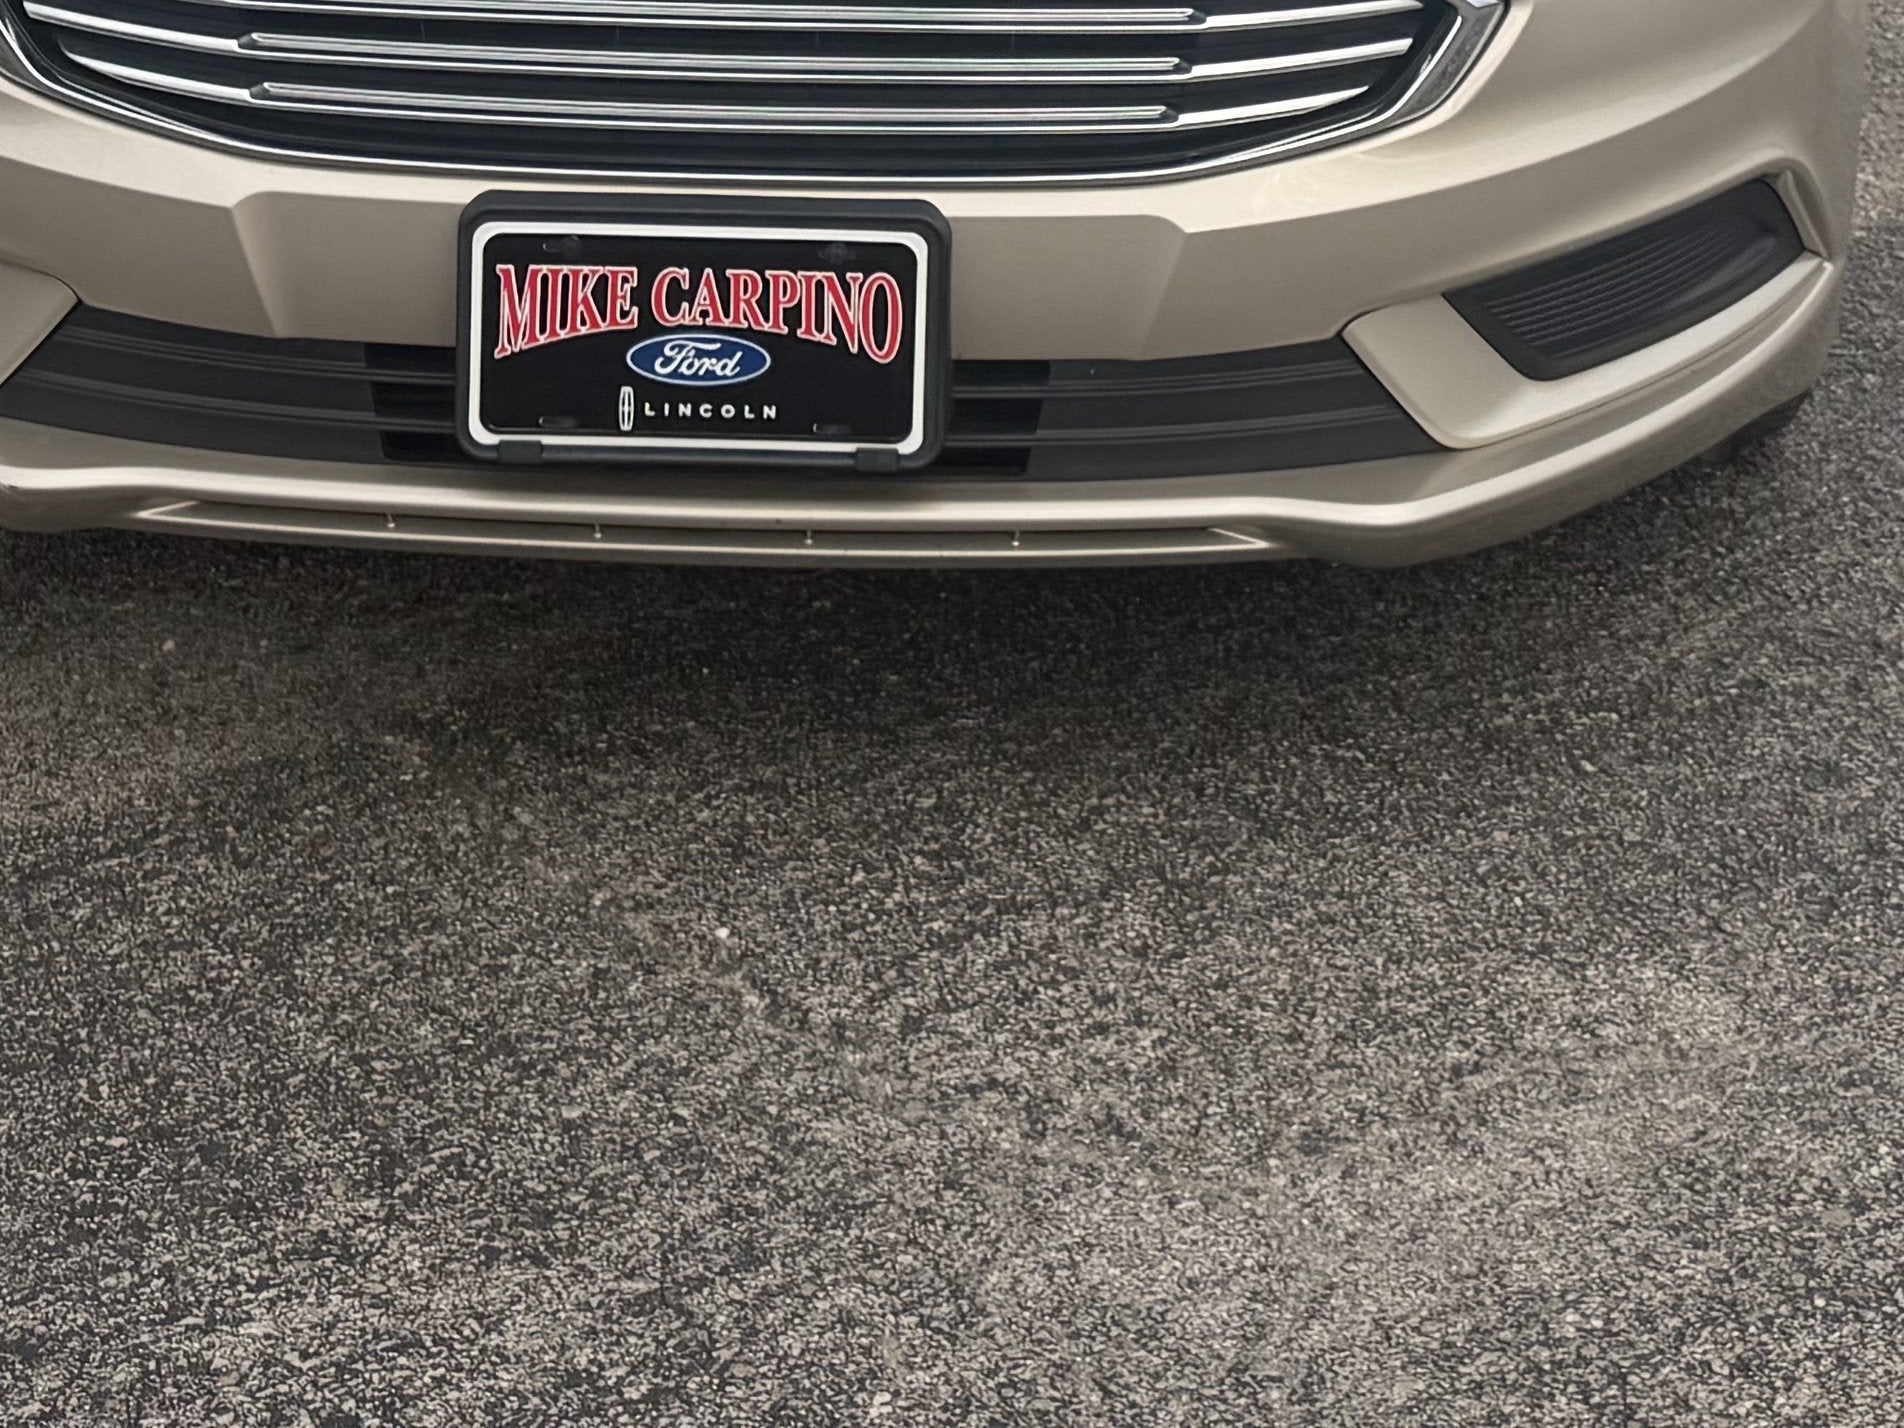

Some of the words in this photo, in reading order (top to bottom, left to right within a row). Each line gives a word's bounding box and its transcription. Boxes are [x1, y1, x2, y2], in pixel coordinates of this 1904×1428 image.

[494, 264, 638, 359] MIKE
[651, 267, 903, 364] CARPINO
[654, 339, 742, 377] Ford
[644, 401, 777, 421] LINCOLN
